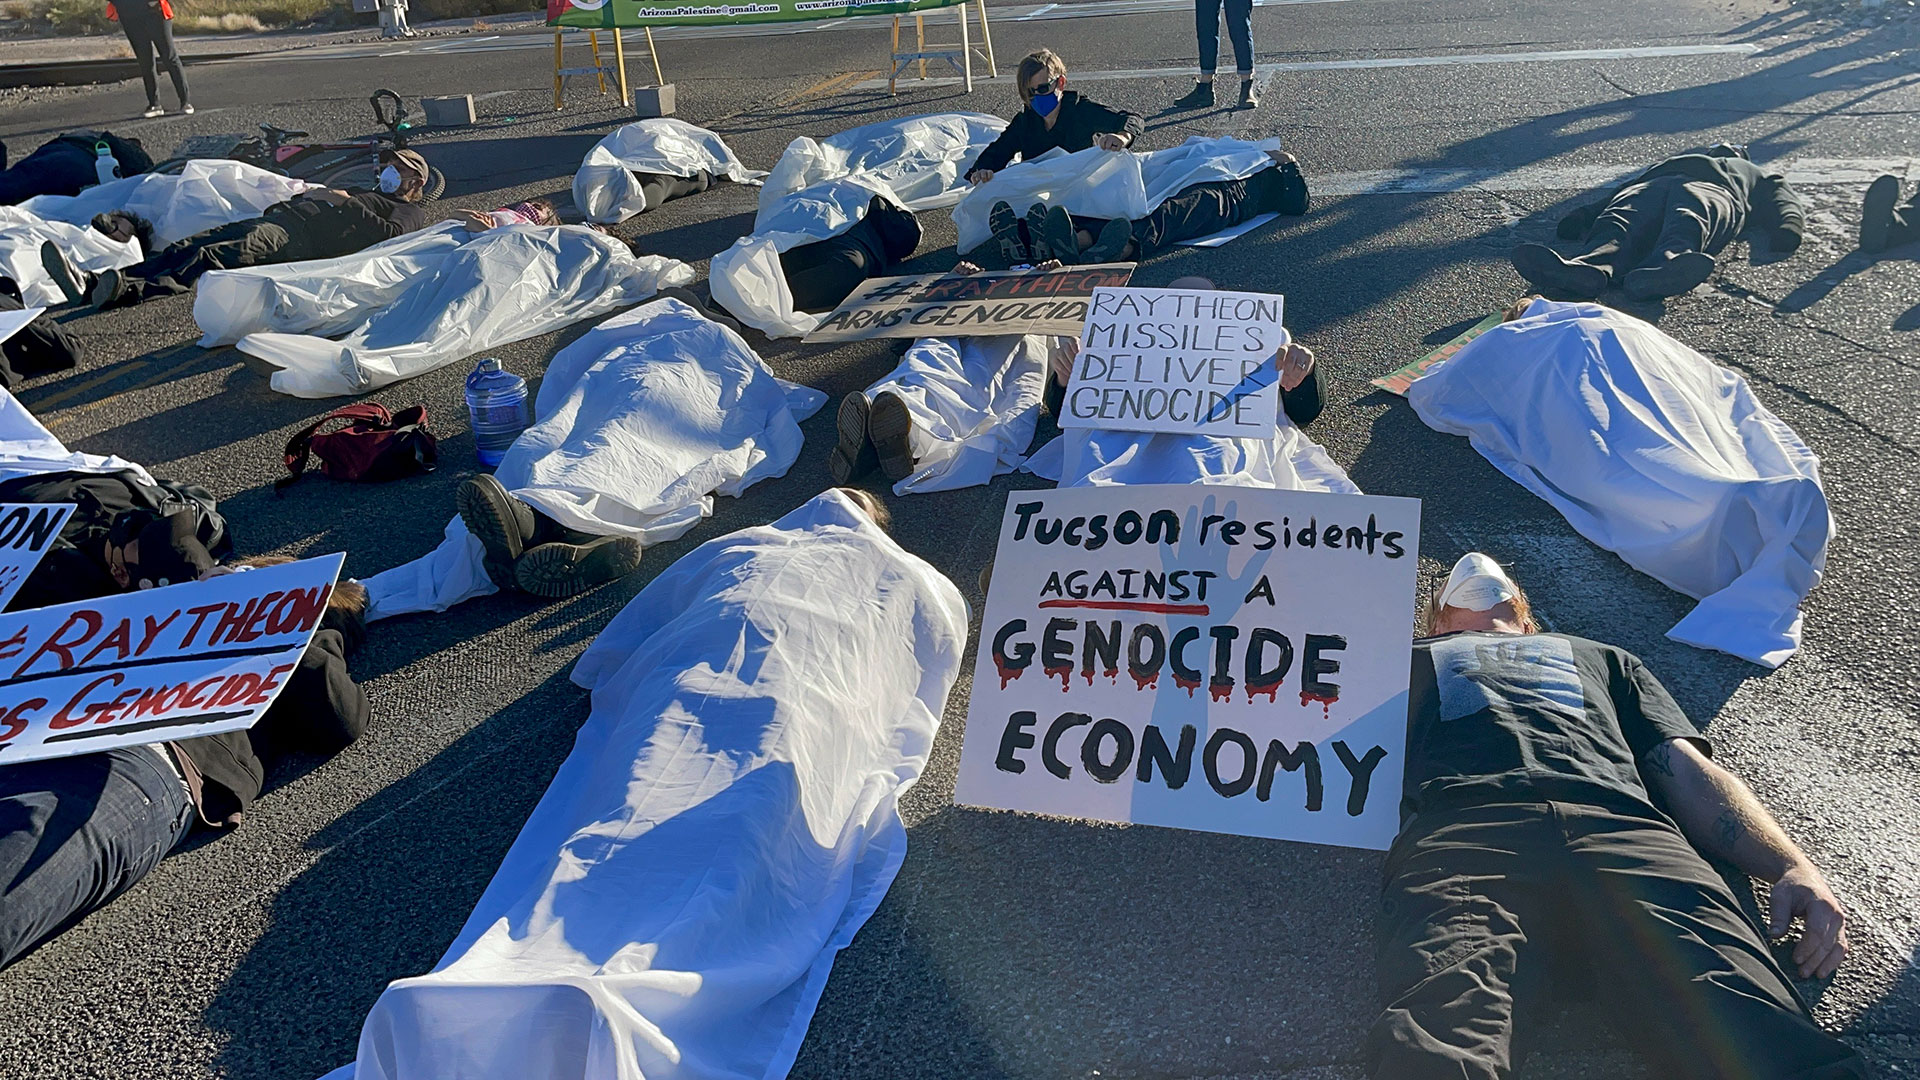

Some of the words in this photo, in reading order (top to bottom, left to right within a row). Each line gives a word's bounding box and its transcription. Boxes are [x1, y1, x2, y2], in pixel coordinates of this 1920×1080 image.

[639, 4, 779, 18] ArizonaPalestine@gmail.com
[820, 307, 912, 332] ARMS
[910, 300, 1089, 326] GENOCID
[1092, 292, 1278, 323] RAYTHEON
[1086, 322, 1264, 352] MISSILES
[1080, 354, 1264, 388] DELIVER
[1071, 388, 1262, 427] GENOCIDE
[0, 507, 67, 552] ON
[1014, 501, 1180, 550] Tucson
[1199, 513, 1405, 559] residents
[1039, 569, 1218, 601] AGAINST
[1244, 575, 1276, 606] A
[992, 617, 1348, 712] GENOCIDE
[0, 698, 48, 741] S
[50, 664, 295, 730] GENOCIDE
[994, 710, 1388, 817] ECONOMY
